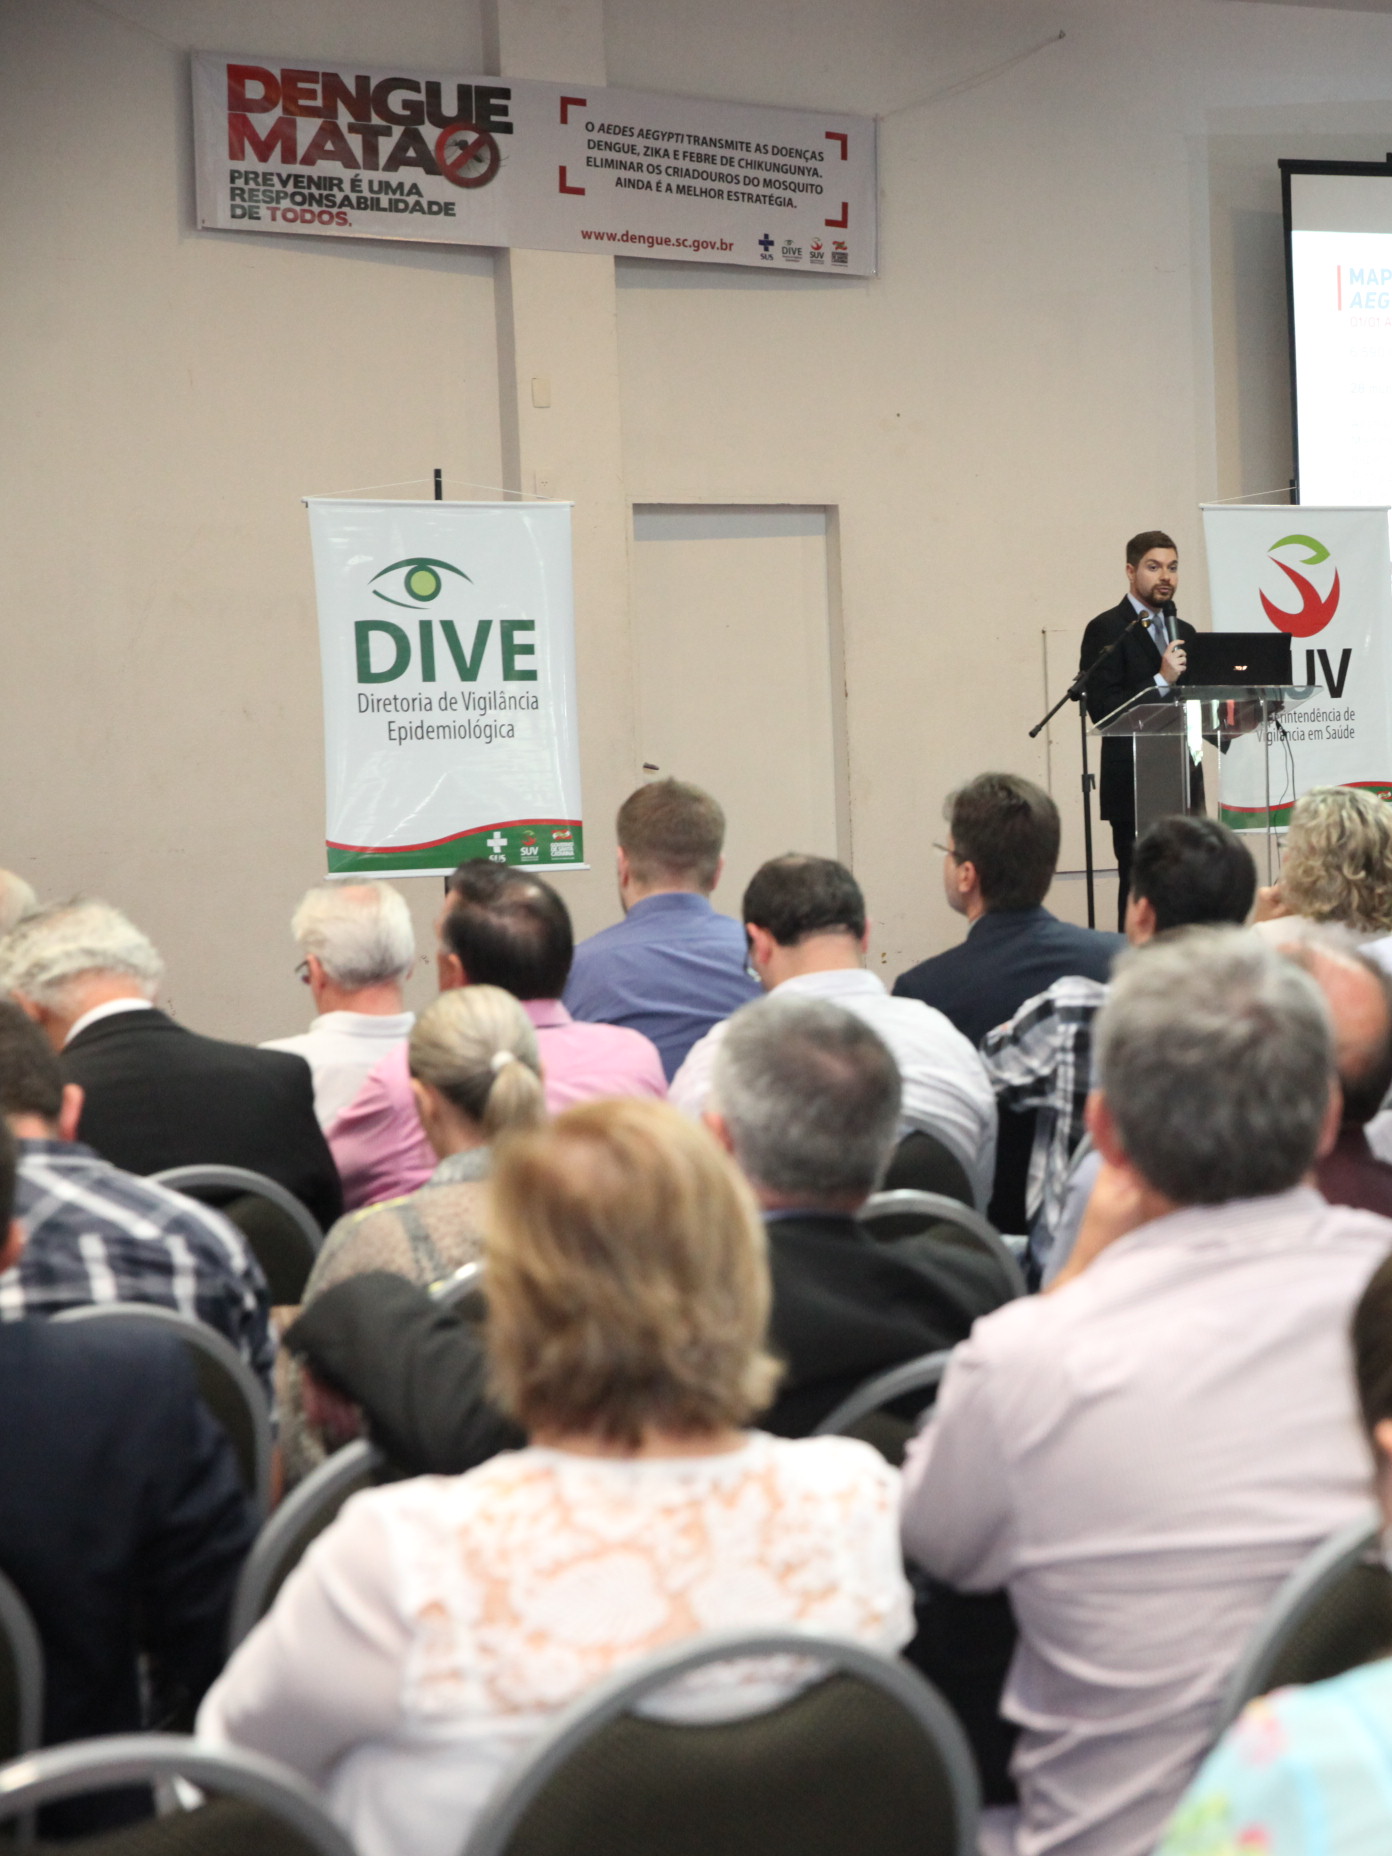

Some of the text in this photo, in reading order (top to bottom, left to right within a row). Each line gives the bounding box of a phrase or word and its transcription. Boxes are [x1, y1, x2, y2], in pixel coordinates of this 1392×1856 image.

[226, 63, 513, 135] DENGUE
[585, 121, 825, 163] O AEDES AEGYPTI TRANSMITE AS DOENÇAS
[587, 139, 823, 179] DENGUE, ZIKA E FEBRE DE CHIKUNGUNYA.
[229, 169, 424, 198] PREVENIR É UMA
[586, 156, 824, 196] ELIMINAR OS CRIADOUROS DO MOSQUITO
[229, 186, 457, 217] RESPONSABILIDADE
[615, 176, 798, 210] AINDA É A MELHOR ESTRATÉGIA.
[230, 203, 353, 228] DE TODOS.
[580, 229, 735, 252] www.dengue.sc.gov.br
[354, 619, 538, 684] DIVE
[1284, 647, 1353, 701] UV
[357, 690, 540, 717] Diretoria de Vigilância
[1343, 706, 1356, 721] de
[387, 717, 516, 747] Epidemiológica
[1307, 730, 1324, 741] em
[1325, 724, 1356, 740] Saúde
[520, 846, 540, 856] SUV
